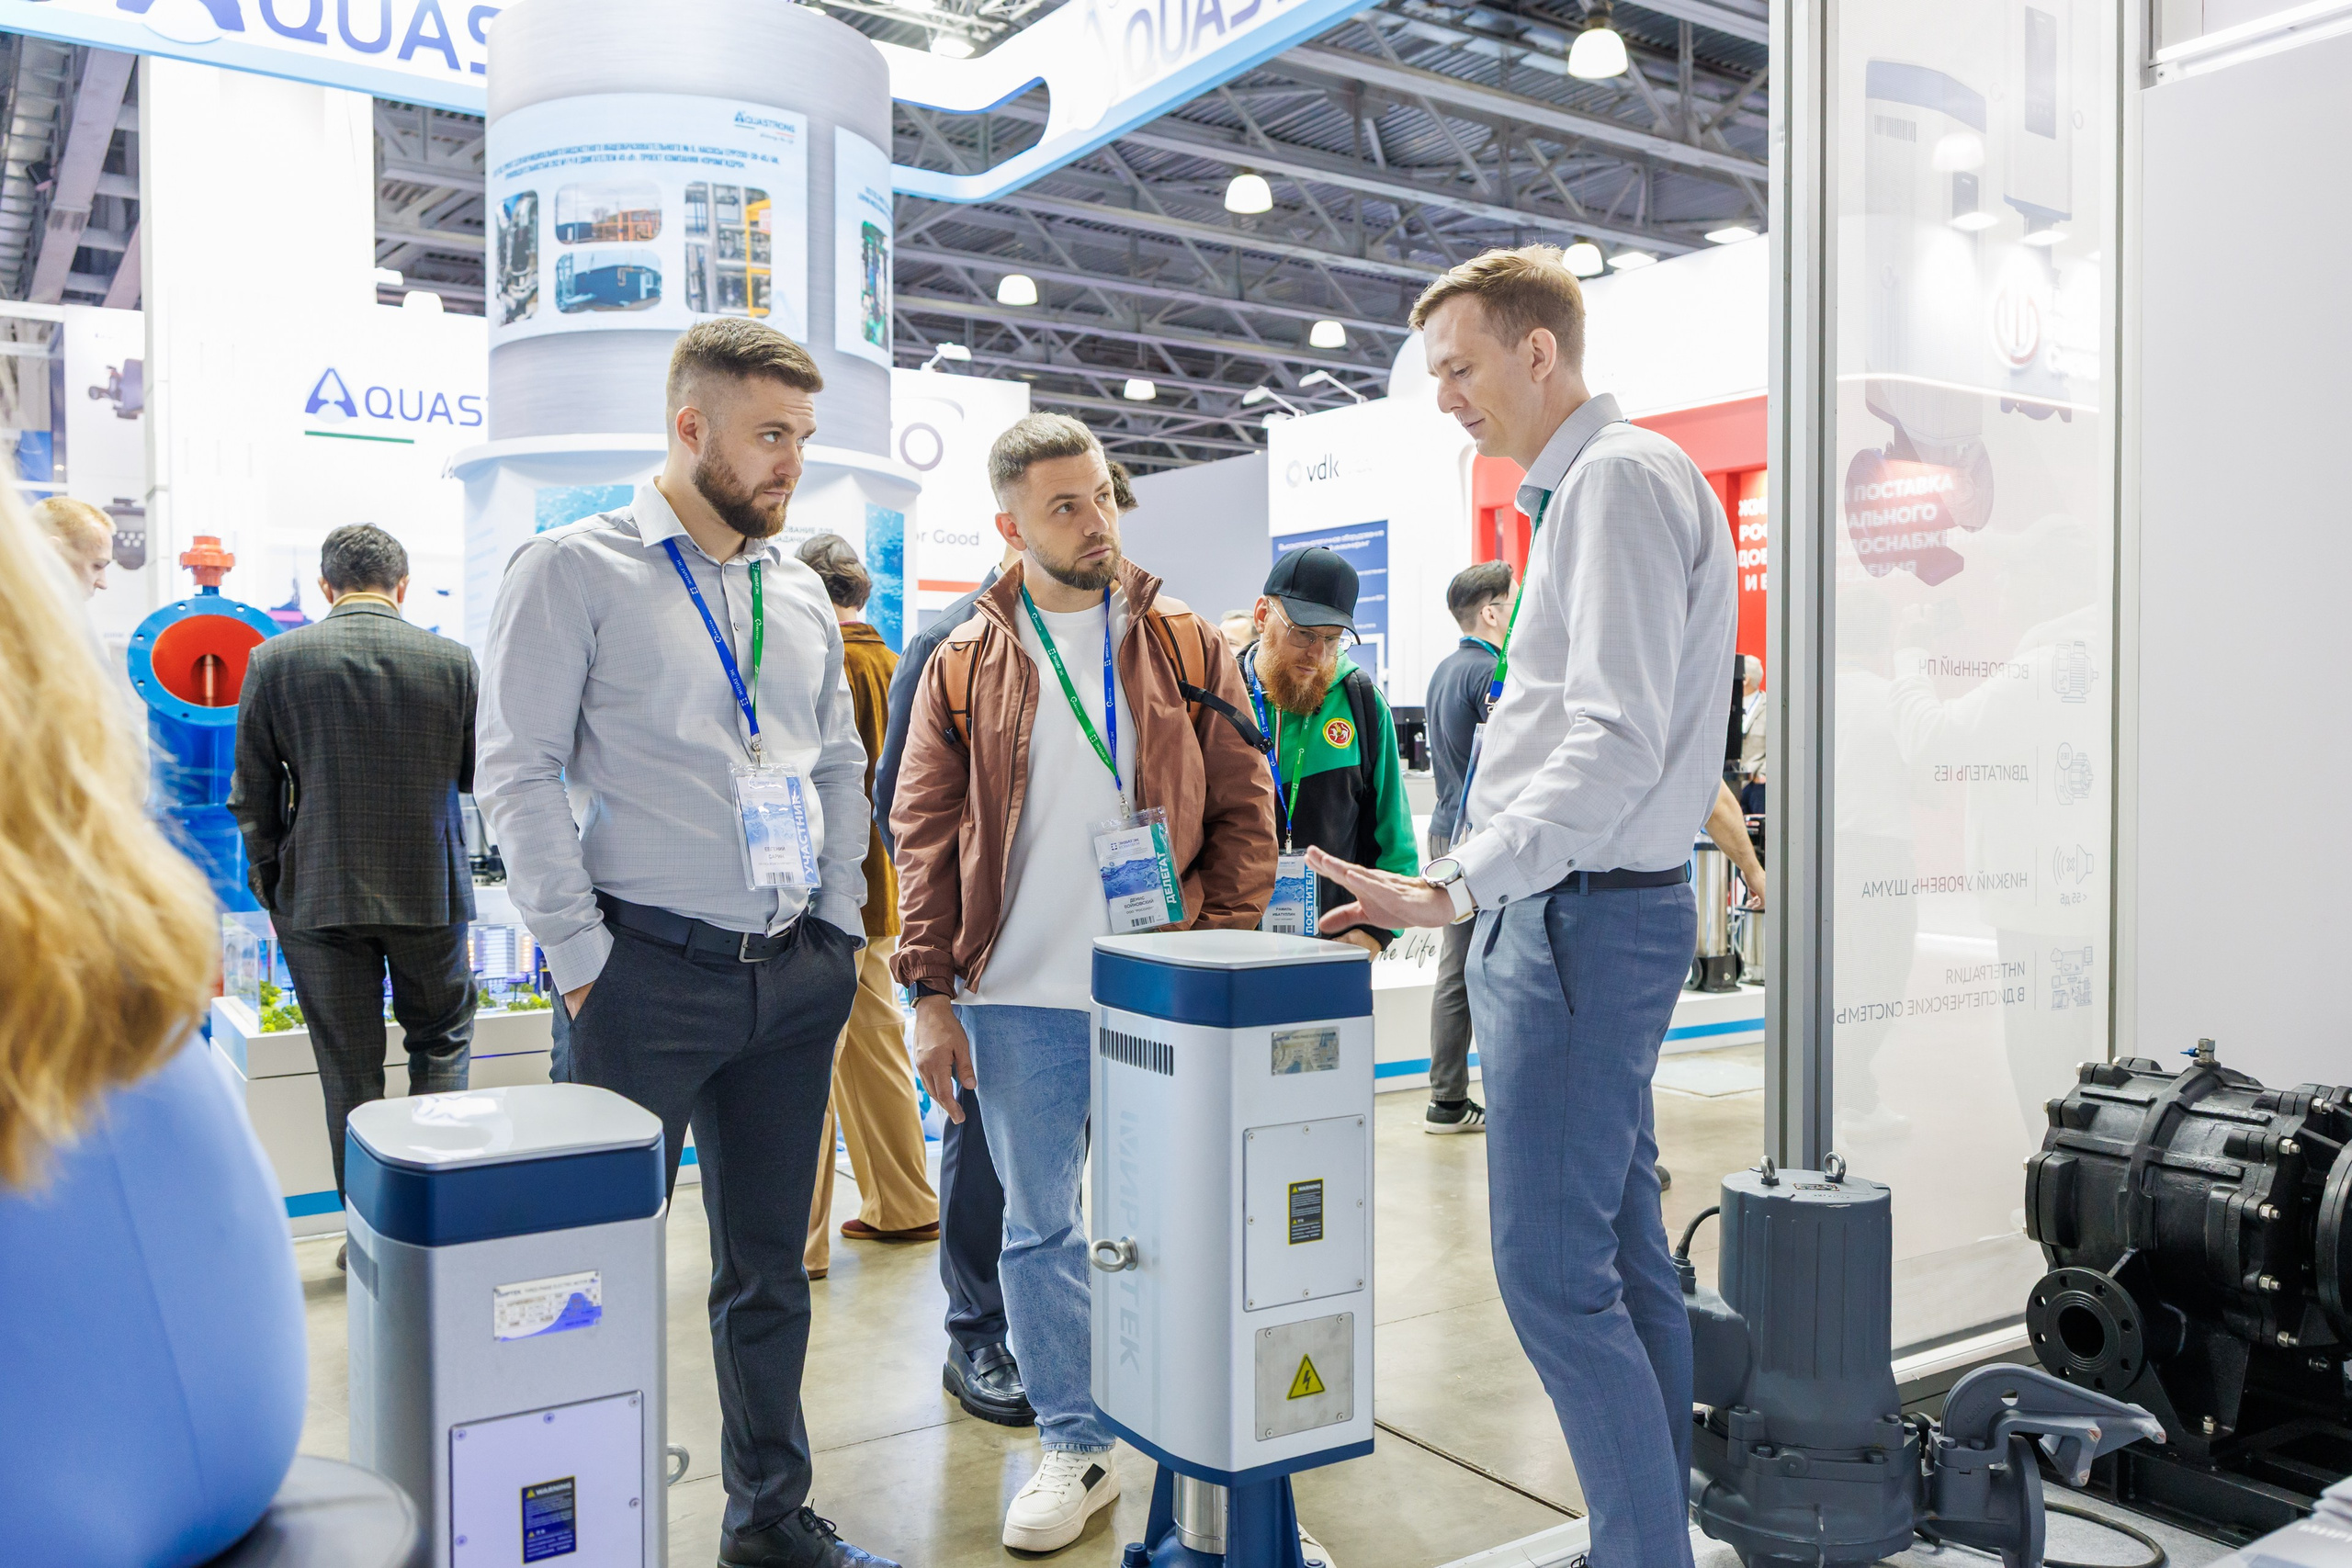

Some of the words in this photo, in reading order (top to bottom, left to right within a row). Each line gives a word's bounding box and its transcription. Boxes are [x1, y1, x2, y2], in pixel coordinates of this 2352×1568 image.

[305, 367, 487, 426] AQUAS
[1306, 453, 1340, 482] vdk
[933, 529, 979, 546] Good
[793, 794, 814, 875] УЧАСТНИК
[1156, 852, 1177, 905] ДЕЛЕГАТ
[1306, 868, 1314, 934] ПОСЕТИТЕЛ
[1405, 933, 1437, 968] Life
